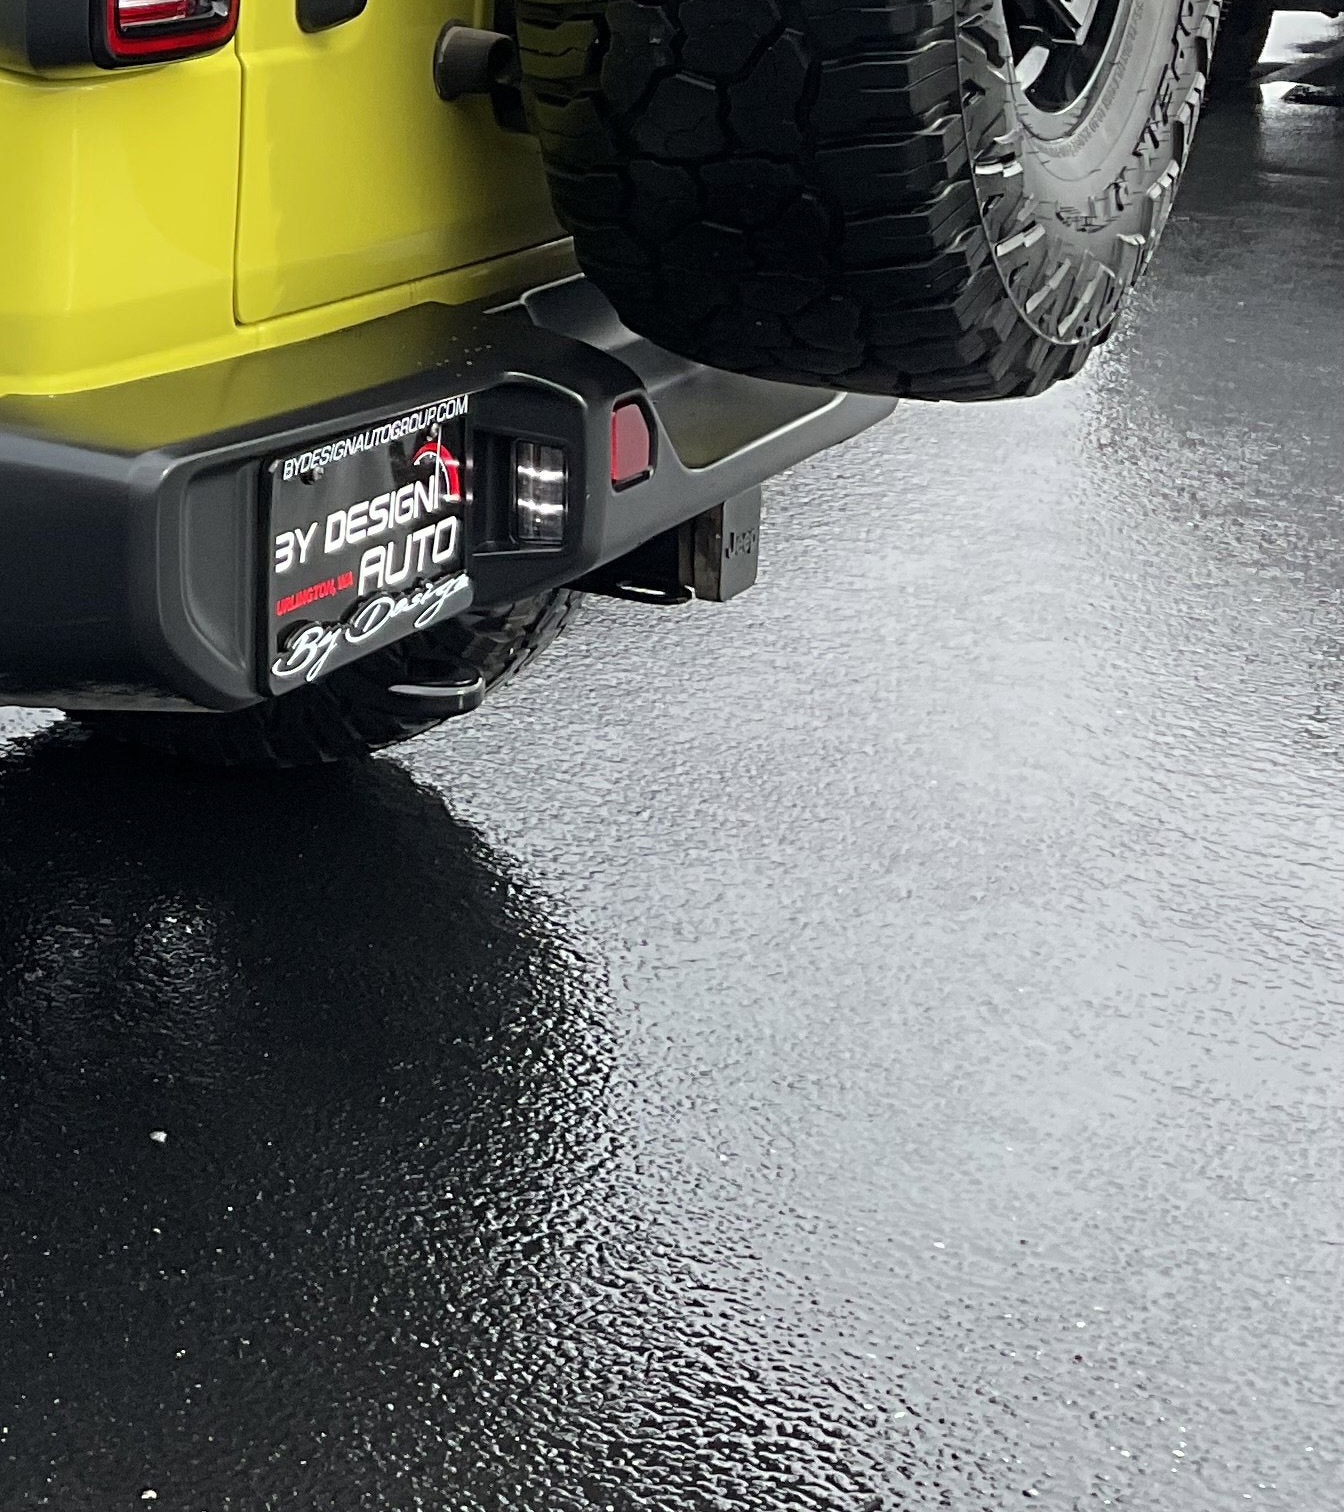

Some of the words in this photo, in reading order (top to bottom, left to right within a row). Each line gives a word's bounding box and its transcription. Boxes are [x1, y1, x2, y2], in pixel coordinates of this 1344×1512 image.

[275, 522, 318, 573] BY
[324, 474, 435, 554] DESIGN
[358, 496, 457, 596] AUTO
[271, 625, 345, 682] By
[345, 573, 469, 643] Design
